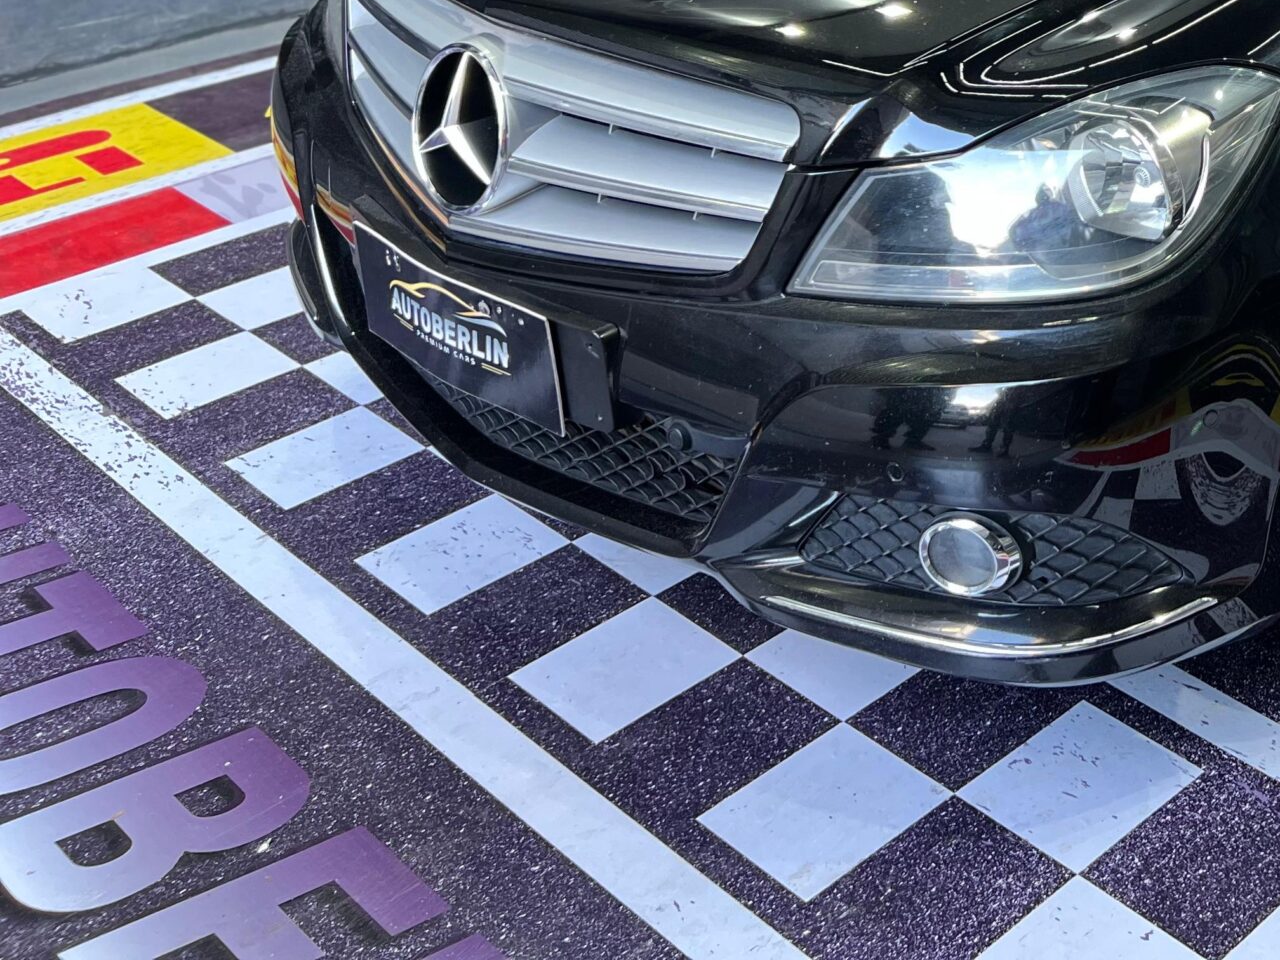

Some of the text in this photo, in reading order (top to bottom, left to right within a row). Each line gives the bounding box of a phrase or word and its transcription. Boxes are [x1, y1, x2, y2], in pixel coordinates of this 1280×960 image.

[390, 287, 510, 369] AUTOBERLIN
[416, 328, 476, 366] PREMIUM CARS
